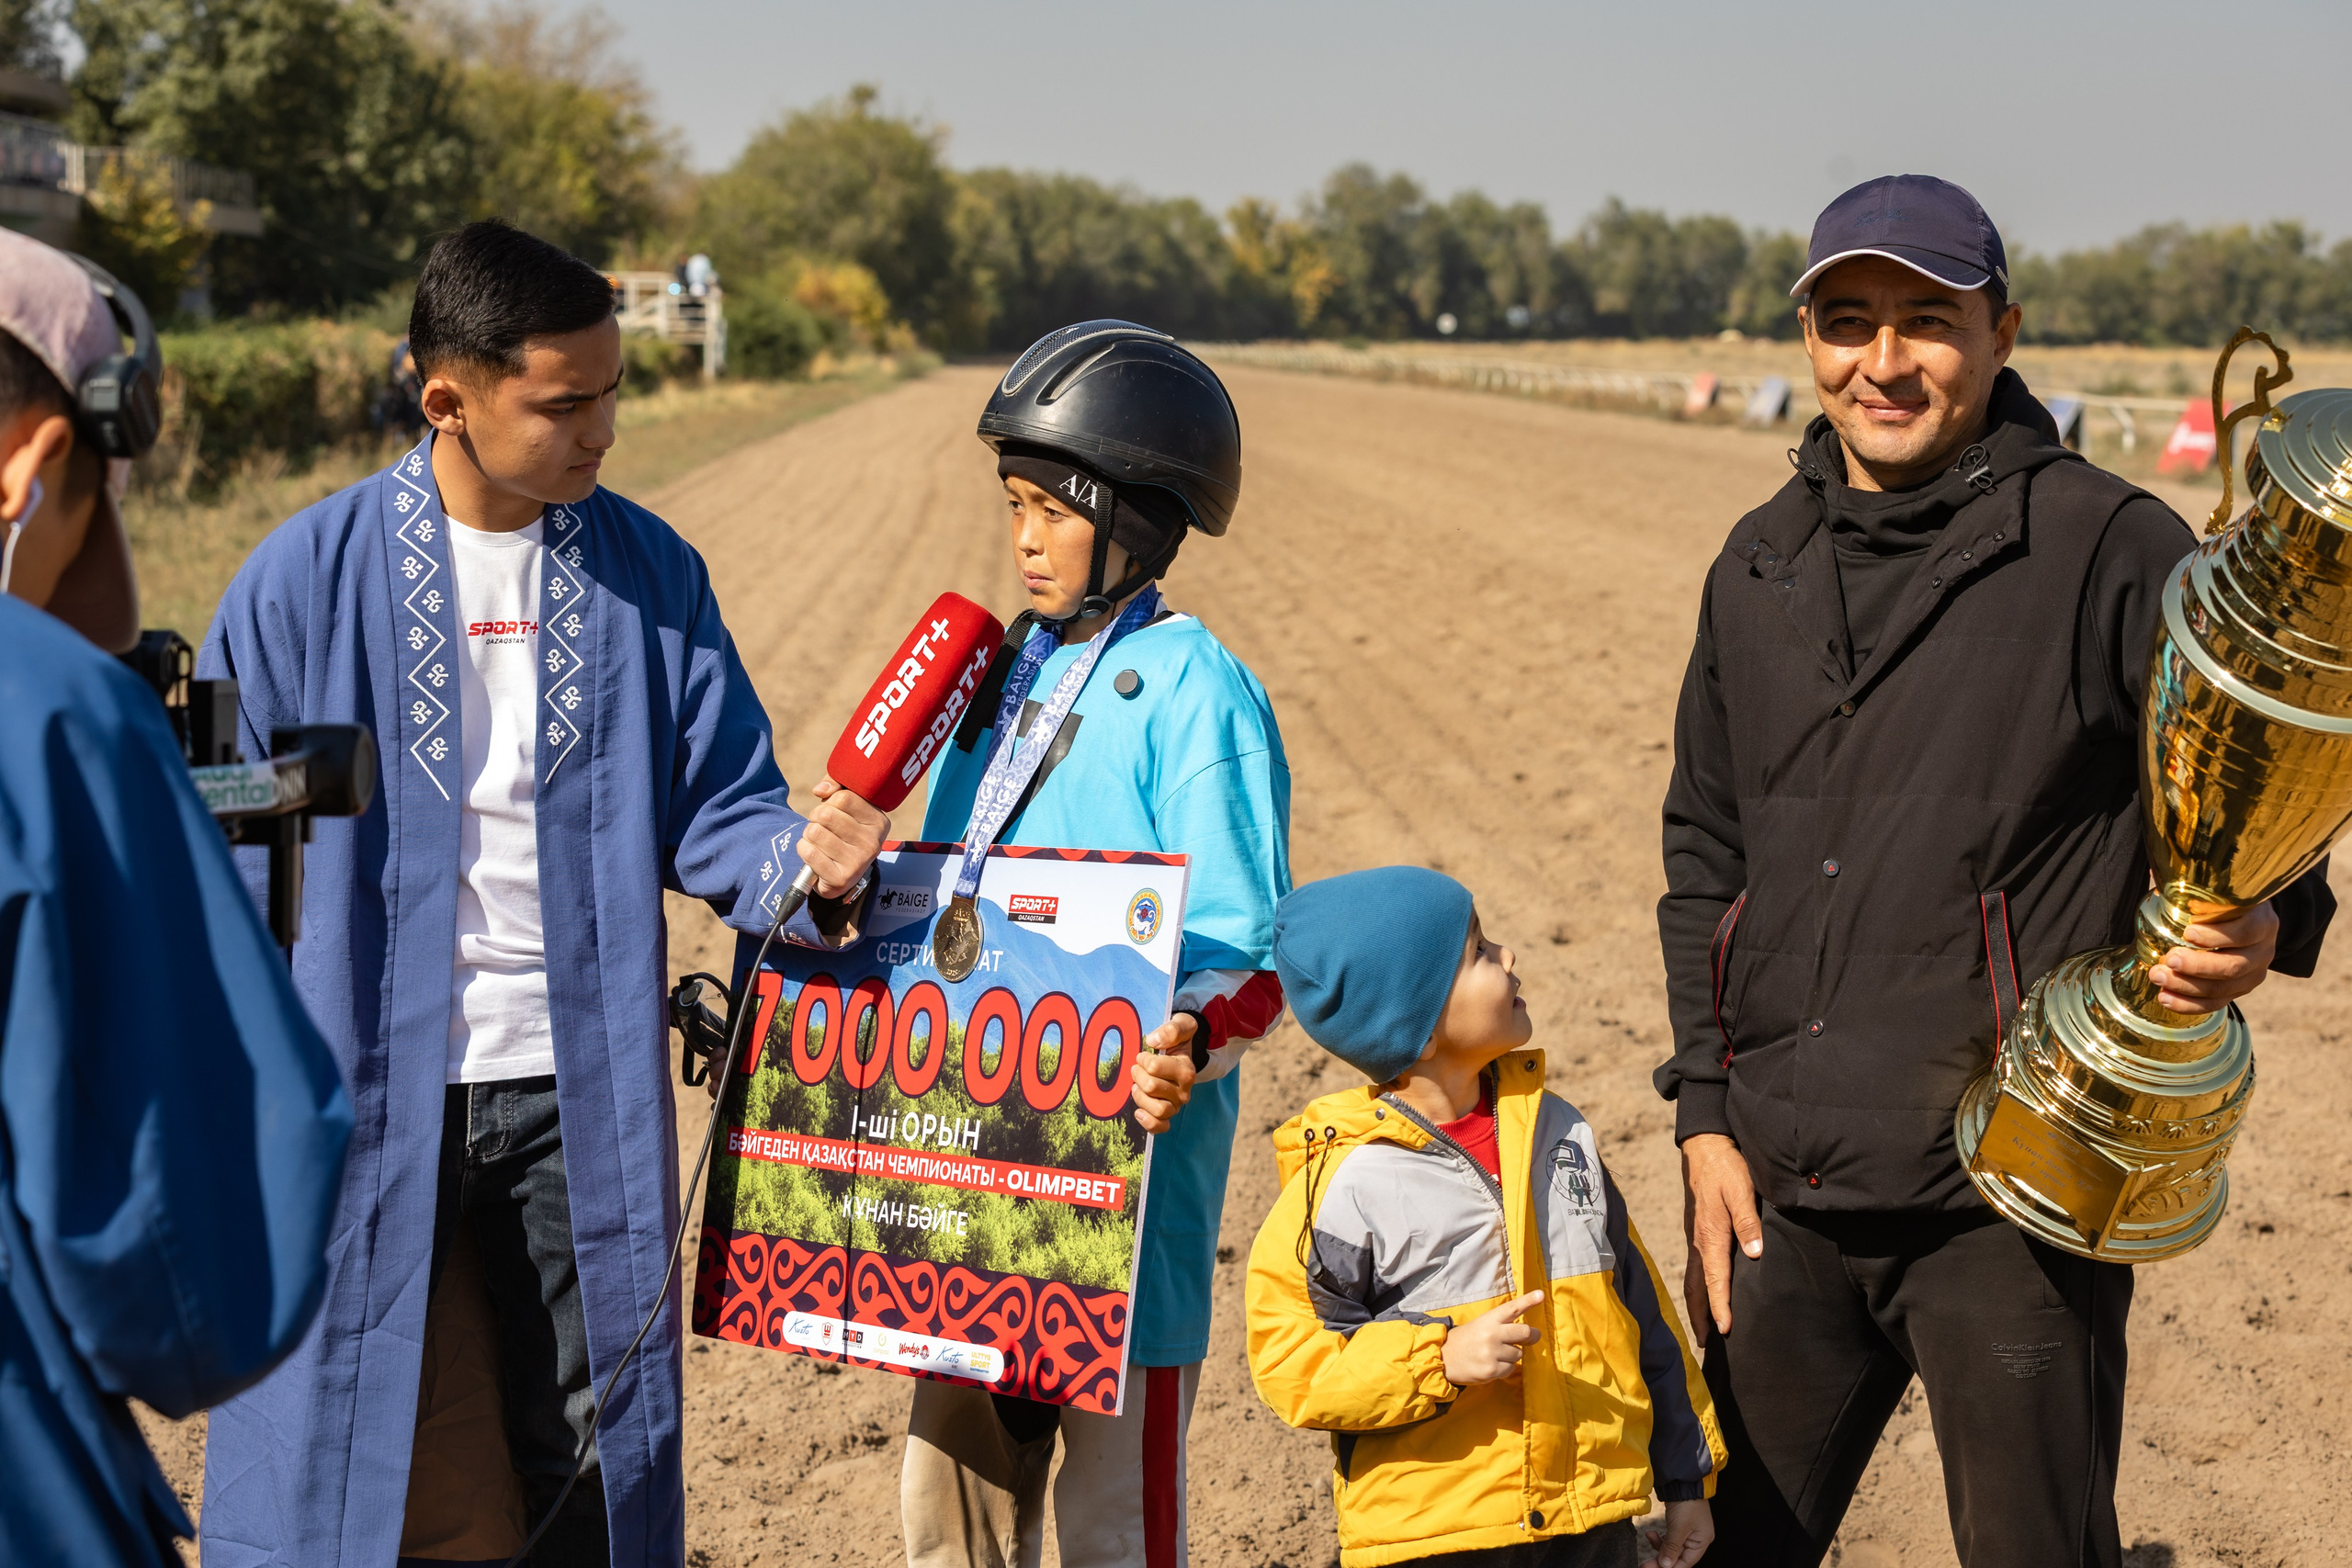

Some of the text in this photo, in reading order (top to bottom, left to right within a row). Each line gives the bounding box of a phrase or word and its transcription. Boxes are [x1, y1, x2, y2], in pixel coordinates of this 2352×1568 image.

[468, 621, 538, 637] SPORT+
[485, 637, 526, 646] QAZAQSTAN
[854, 617, 950, 760] SPORT+
[901, 645, 989, 787] SPORT+
[1011, 897, 1057, 912] SPORT+
[876, 942, 1004, 972] СЕРТИАТ
[901, 1111, 981, 1151] ОРЫН
[729, 1130, 800, 1161] БӘЙГЕДЕН
[801, 1142, 885, 1172] ҚАЗАҚСТАН
[888, 1153, 996, 1187] ЧЕМПИОНАТЫ
[1007, 1169, 1121, 1203] OLIMPBET
[907, 1201, 968, 1236] БӘЙГЕ
[788, 1317, 814, 1336] Kusto
[899, 1342, 921, 1358] Wendy's
[935, 1345, 964, 1364] Kusto
[970, 1359, 990, 1370] SPORT
